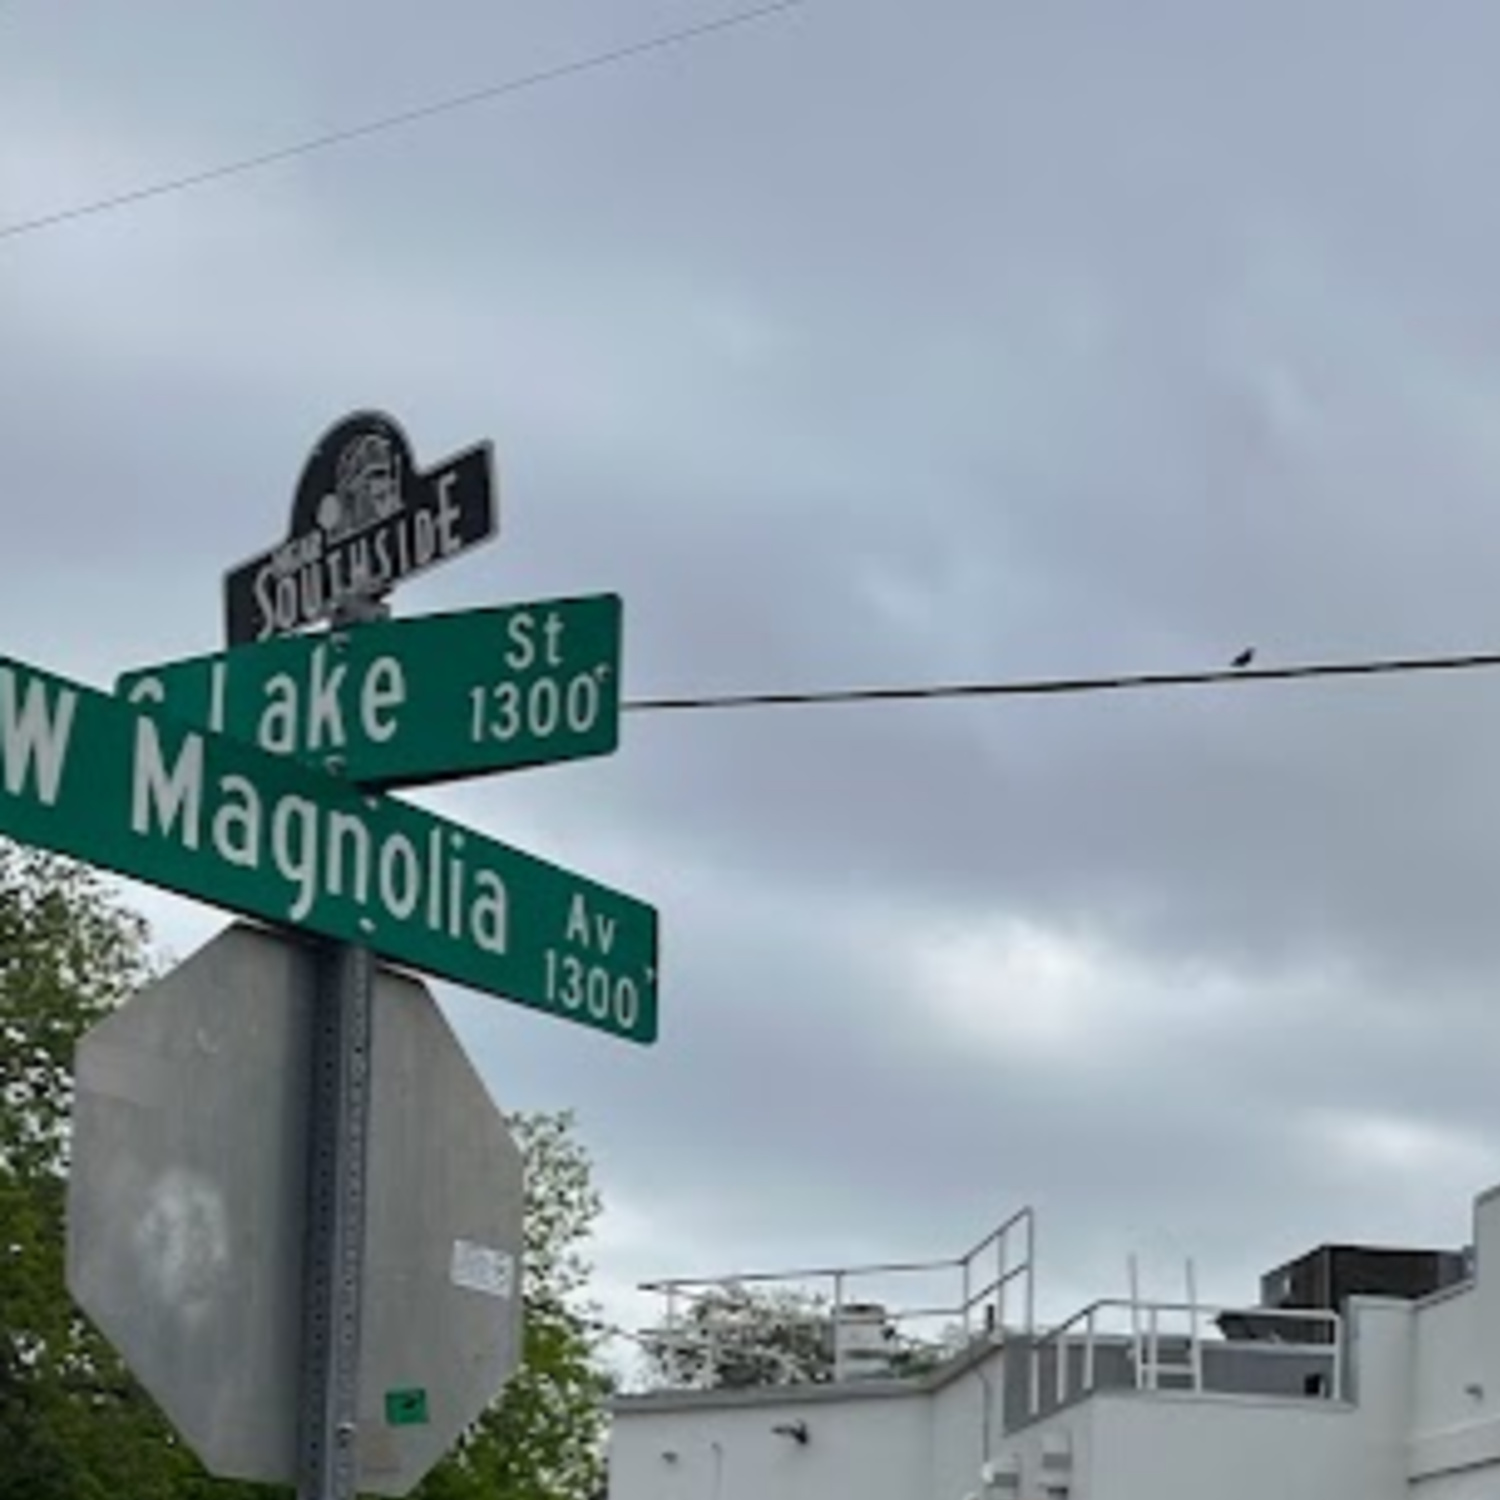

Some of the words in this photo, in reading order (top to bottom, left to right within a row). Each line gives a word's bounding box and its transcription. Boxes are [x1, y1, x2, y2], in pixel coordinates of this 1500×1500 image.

[254, 470, 463, 641] SOUTHSIDE
[506, 610, 564, 671] St
[469, 671, 596, 743] 1300
[0, 667, 77, 806] W
[129, 715, 511, 956] Magnolia
[565, 893, 617, 953] Av
[543, 949, 639, 1031] 1300
